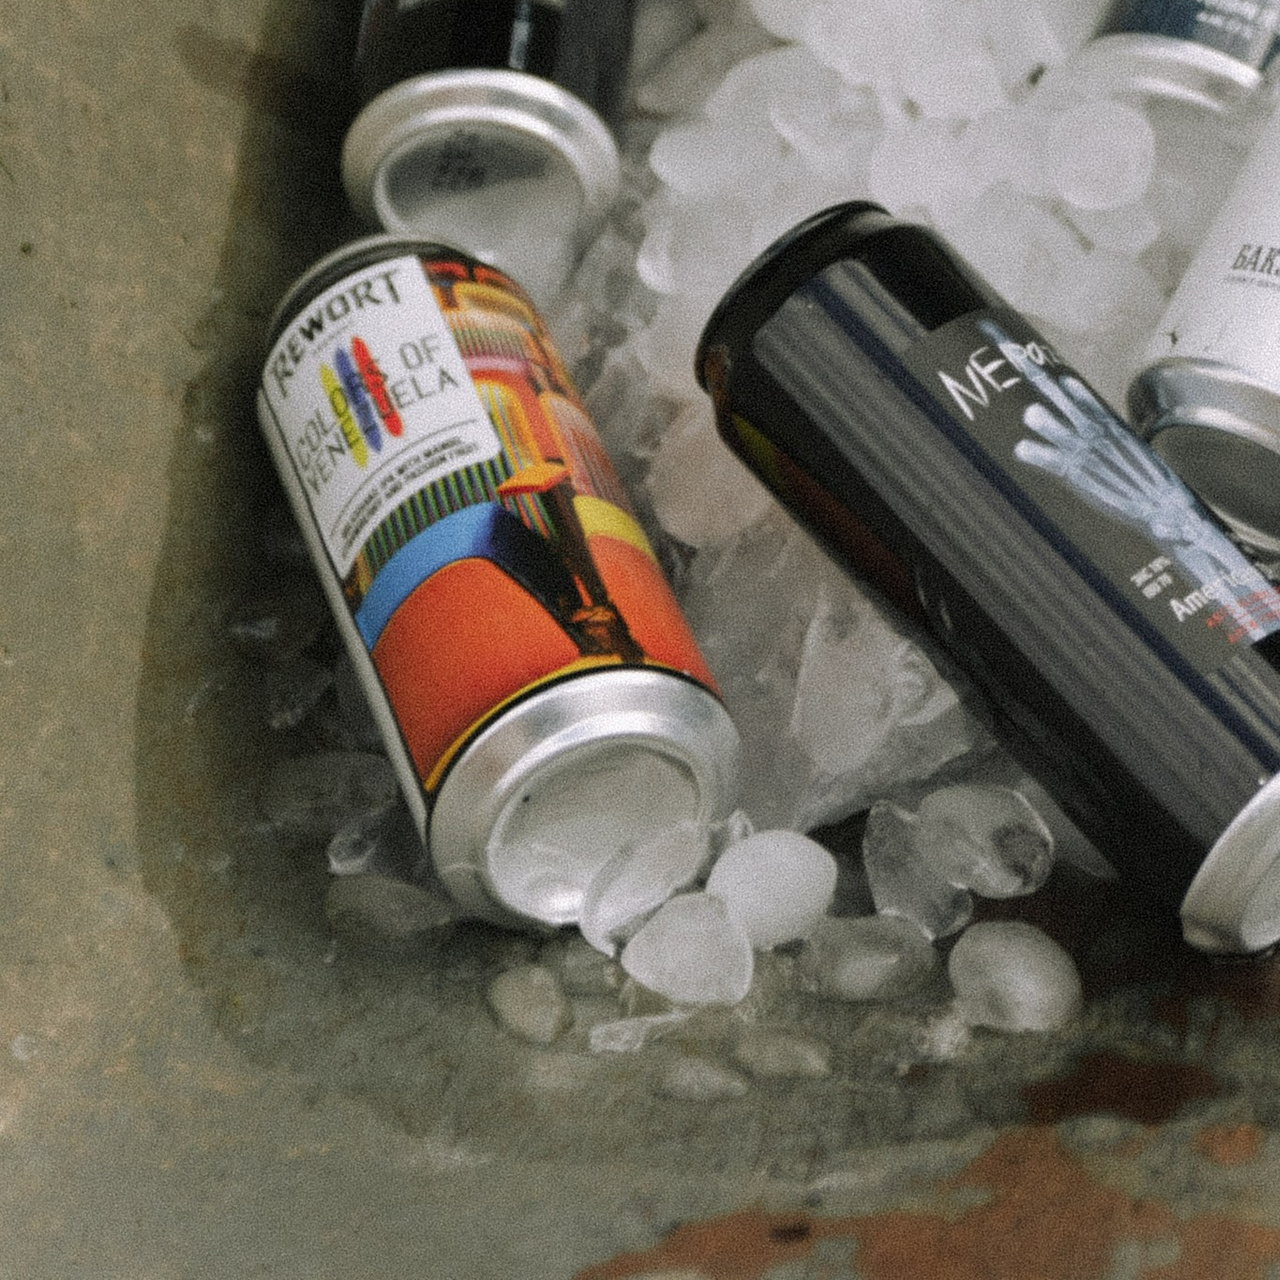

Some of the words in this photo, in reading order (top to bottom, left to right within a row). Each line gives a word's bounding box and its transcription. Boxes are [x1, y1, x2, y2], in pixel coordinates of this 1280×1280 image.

[271, 269, 401, 399] REWORT
[398, 333, 441, 373] OF
[304, 369, 458, 495] VENEZUELA
